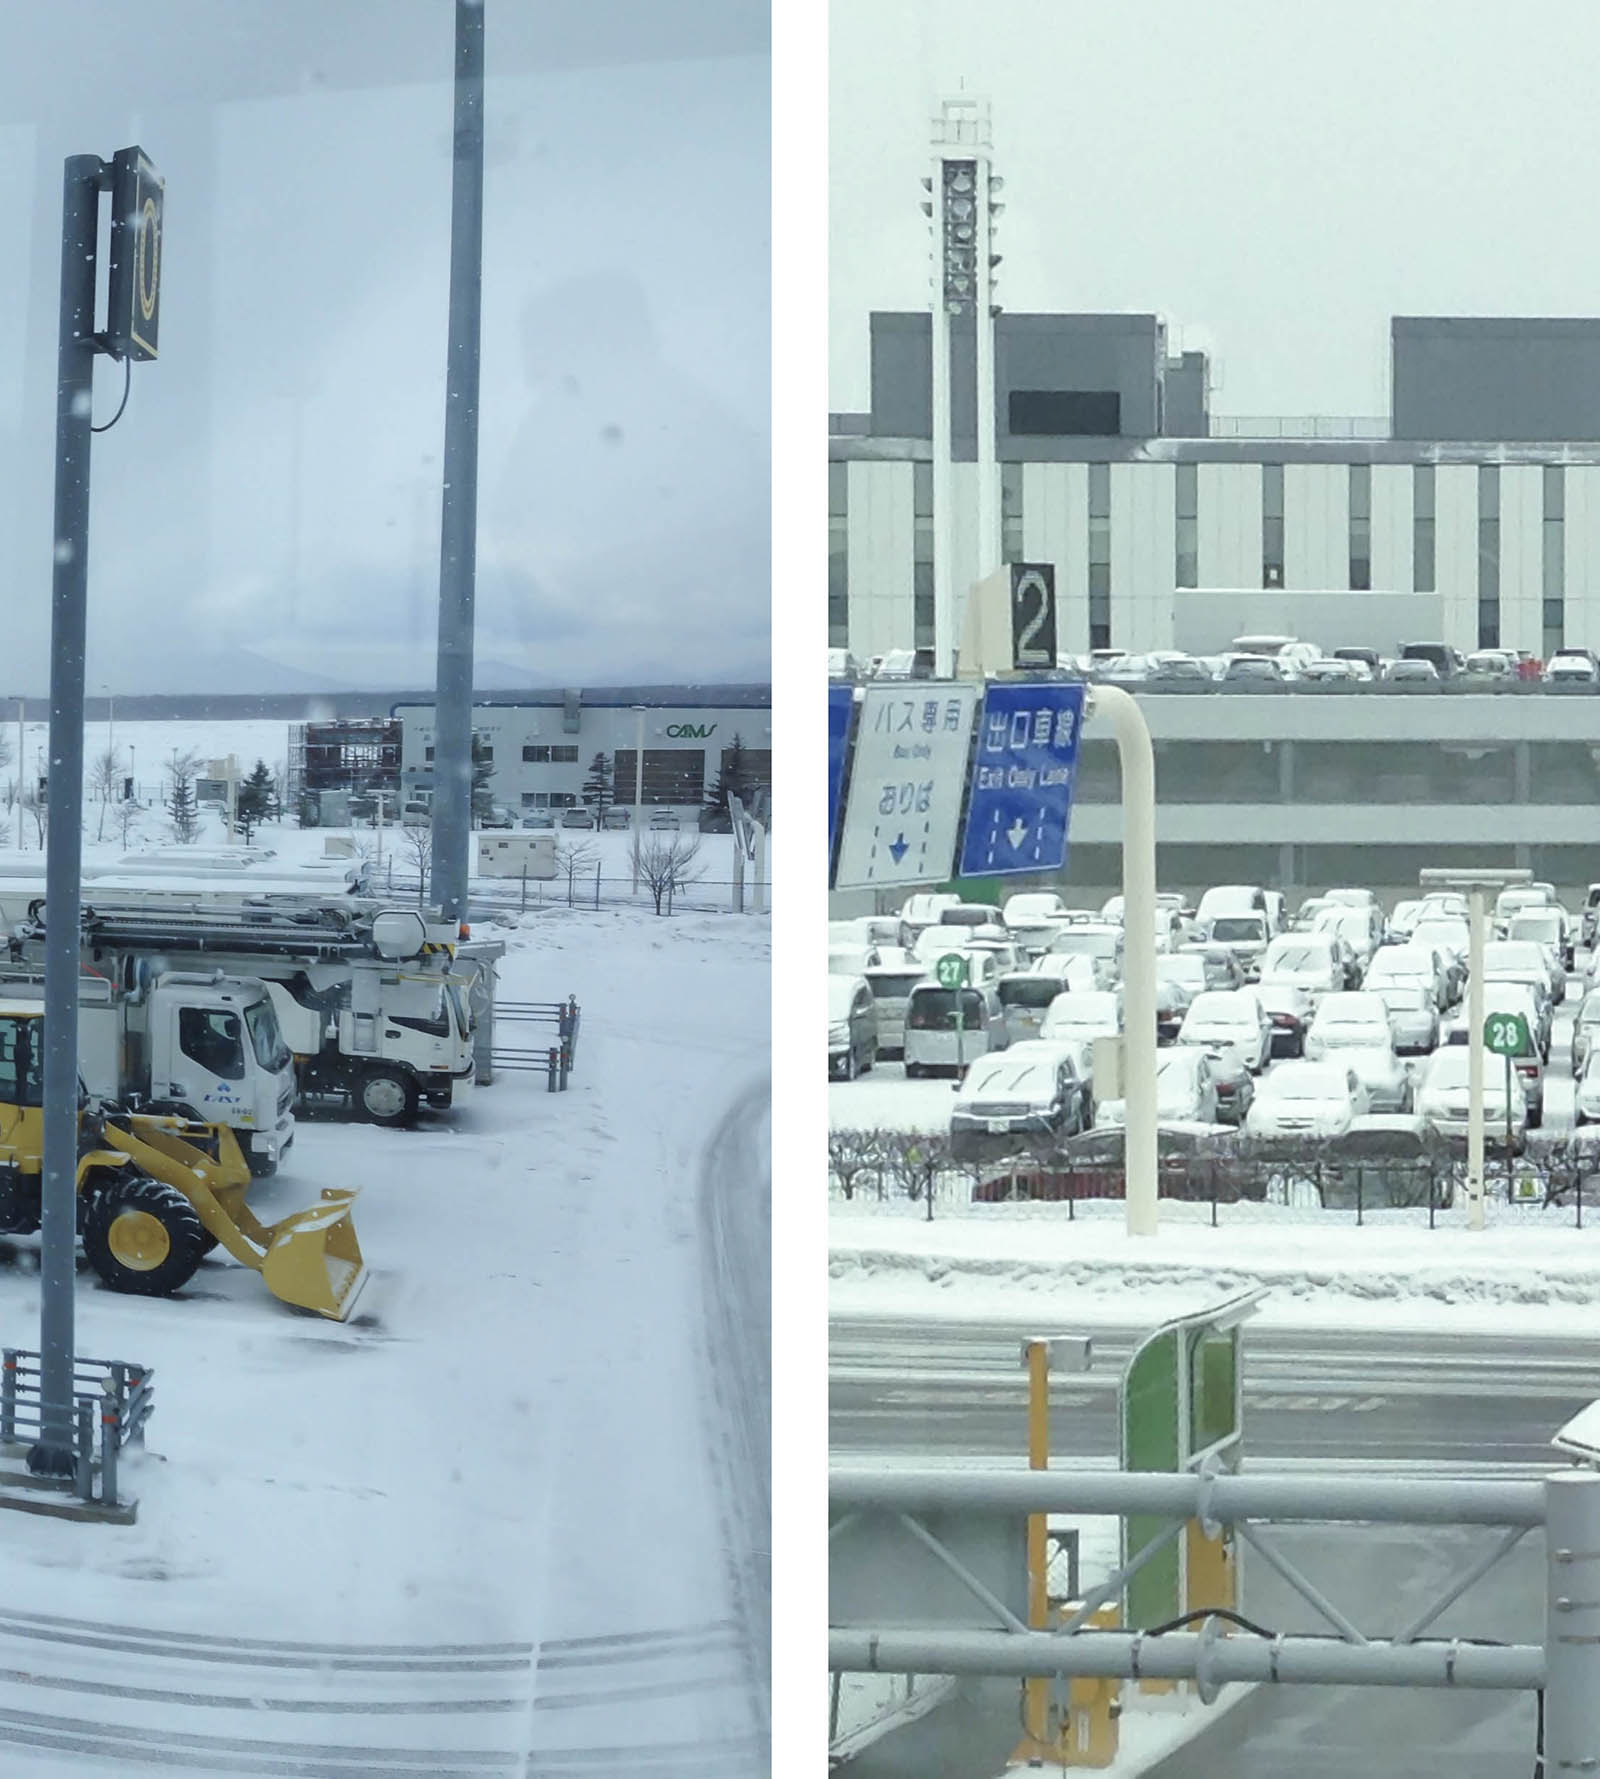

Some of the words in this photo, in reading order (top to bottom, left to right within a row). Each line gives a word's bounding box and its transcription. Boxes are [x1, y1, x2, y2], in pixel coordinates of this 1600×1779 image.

[1017, 569, 1049, 662] 2
[875, 700, 960, 733] バス専用
[986, 707, 1074, 751] 出口車線
[978, 766, 1003, 789] Exit
[1007, 765, 1036, 790] Only
[1039, 763, 1069, 787] Lane
[878, 779, 934, 815] おりば
[939, 961, 961, 982] 27
[1492, 1021, 1519, 1047] 28
